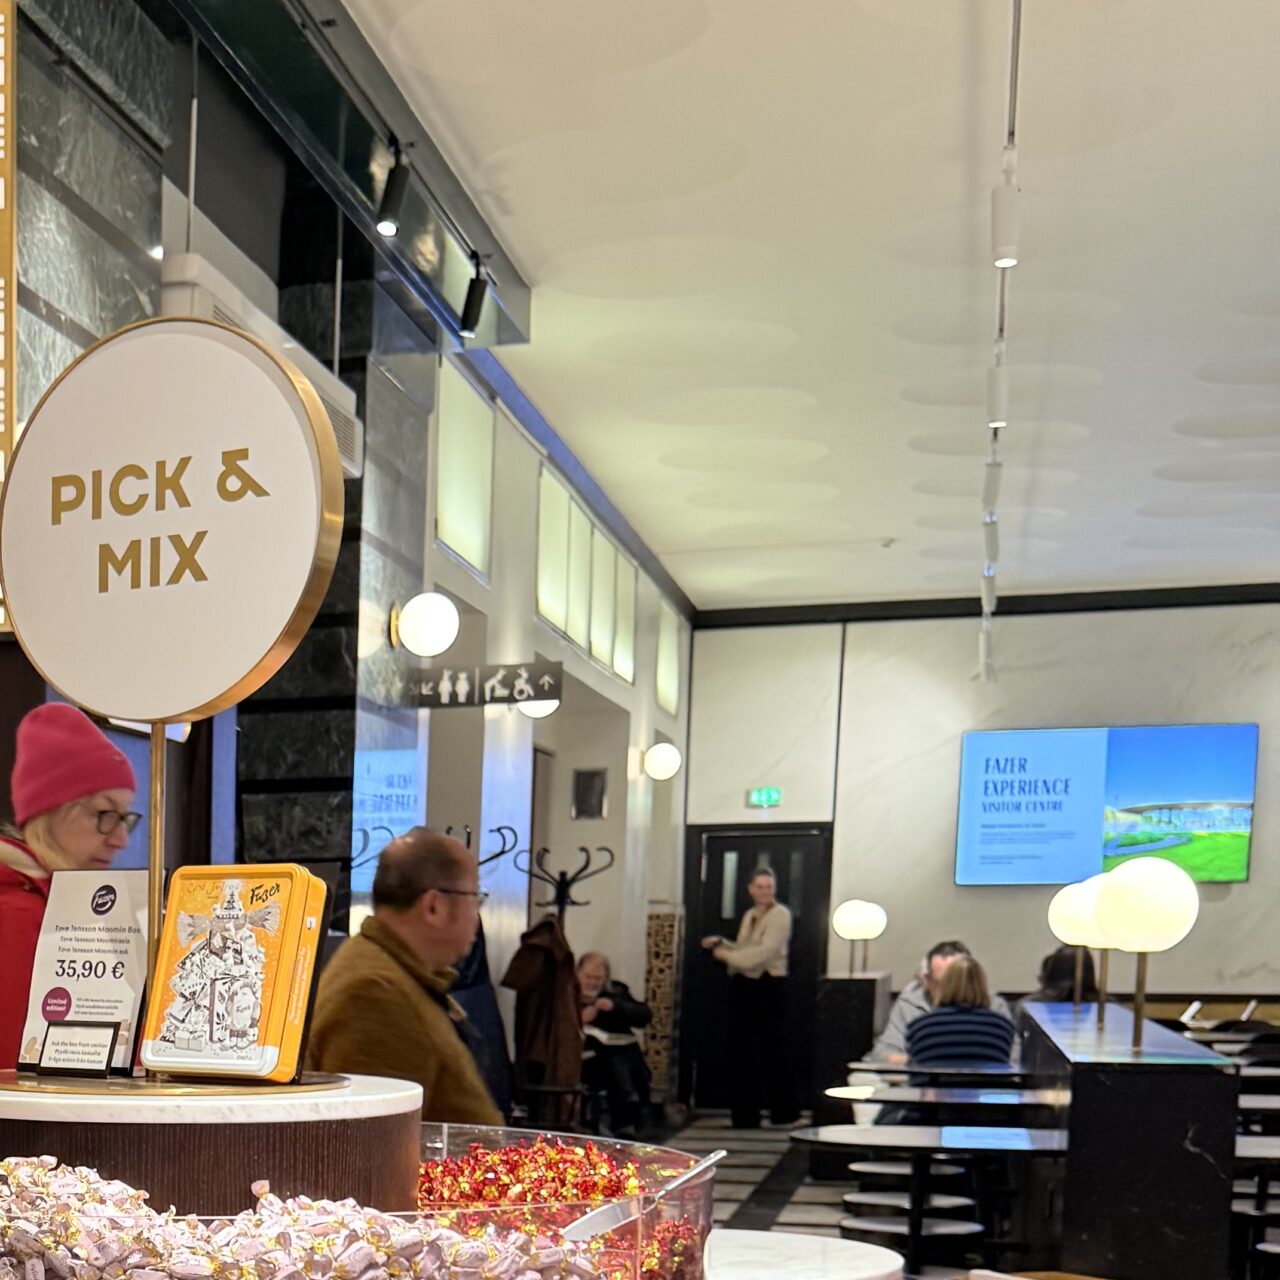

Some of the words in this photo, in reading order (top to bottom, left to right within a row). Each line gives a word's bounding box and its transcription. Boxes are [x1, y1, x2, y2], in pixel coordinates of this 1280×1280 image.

[51, 456, 193, 525] PICK
[216, 448, 271, 502] &
[98, 530, 209, 594] MIX
[984, 757, 1028, 775] FAZER
[983, 778, 1072, 797] EXPERIENCE
[71, 925, 97, 933] Jansson
[98, 925, 127, 933] Moomin
[55, 959, 107, 982] 35,90
[111, 961, 125, 980] €
